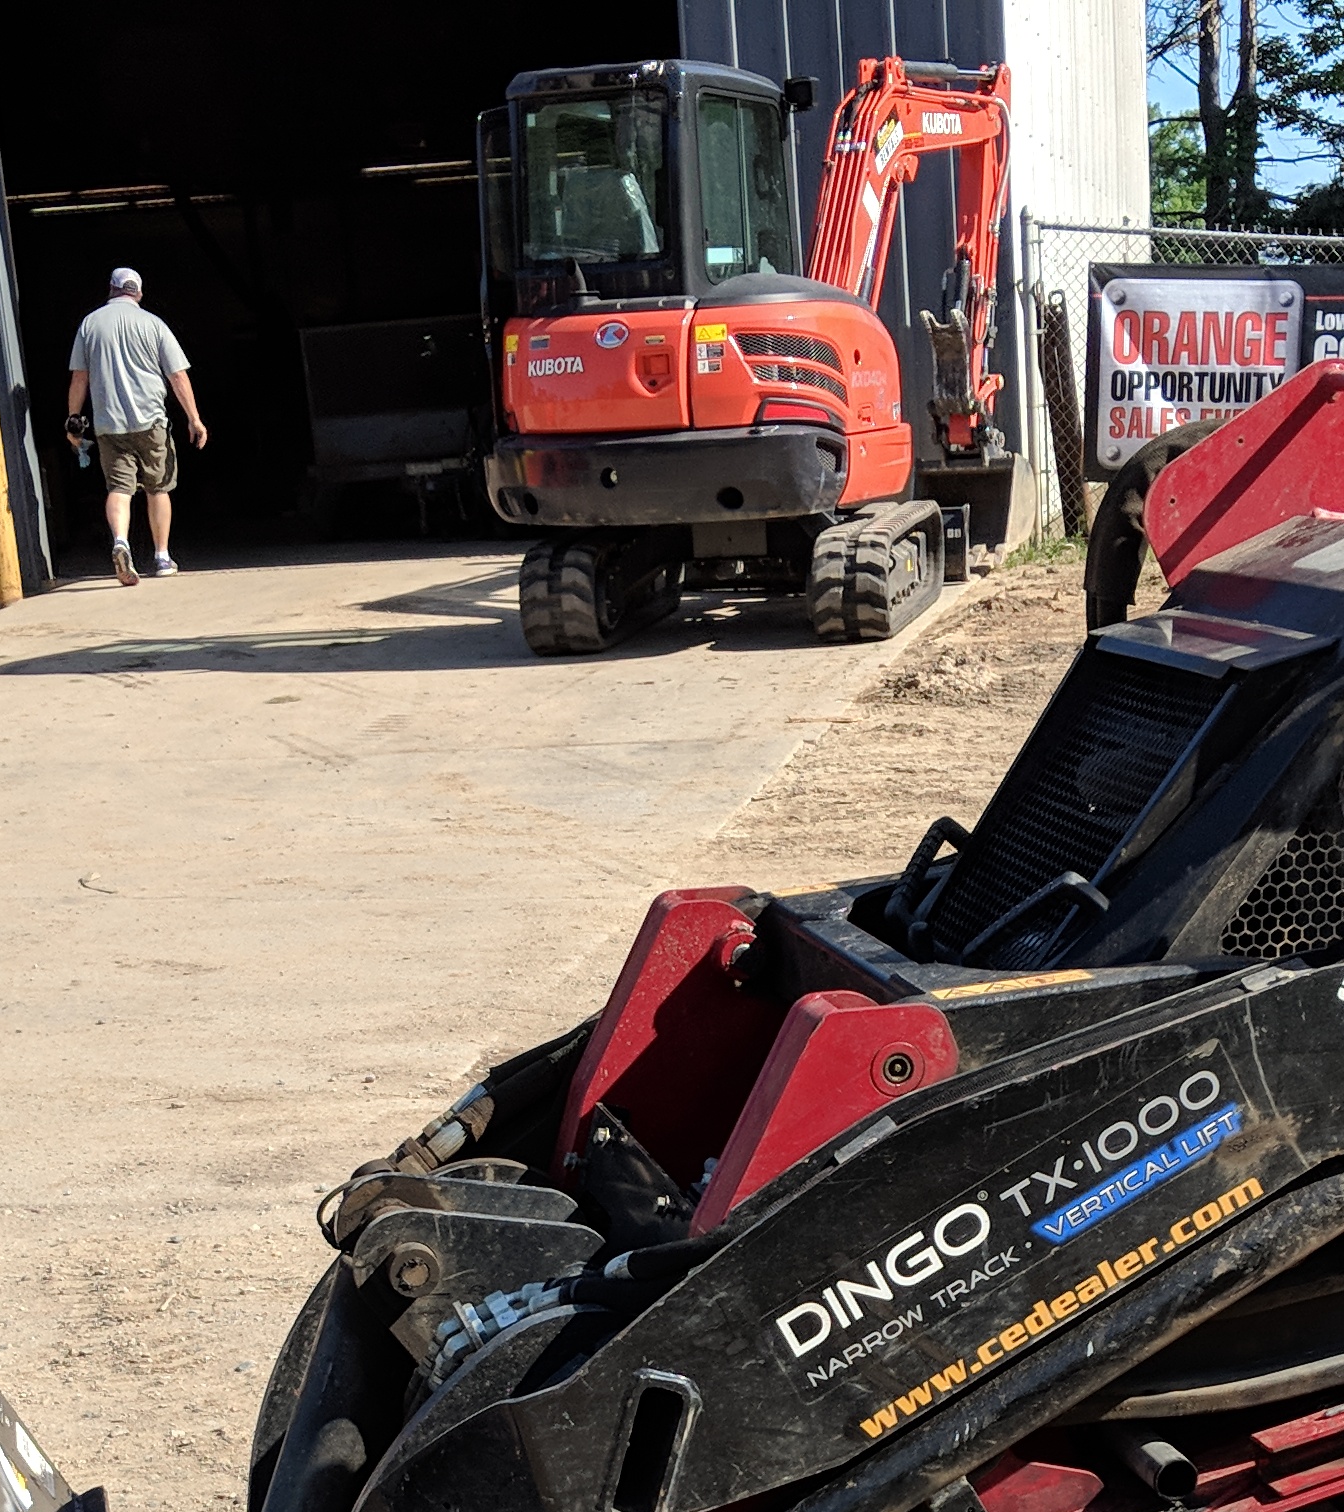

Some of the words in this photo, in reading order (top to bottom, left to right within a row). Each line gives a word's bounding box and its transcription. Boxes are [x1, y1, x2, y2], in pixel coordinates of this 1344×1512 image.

[922, 112, 962, 134] KUBOTA
[1112, 309, 1289, 366] ORANGE
[527, 356, 584, 377] KUBOTA
[1111, 370, 1286, 403] OPPORTUNITY
[805, 1303, 925, 1388] NARROW
[930, 1248, 1021, 1310] TRACK
[1043, 1153, 1179, 1236] VERTICAL
[1179, 1109, 1238, 1162] LIFT
[775, 1202, 991, 1359] DINGO
[859, 1176, 1265, 1440] www.cedealer.com
